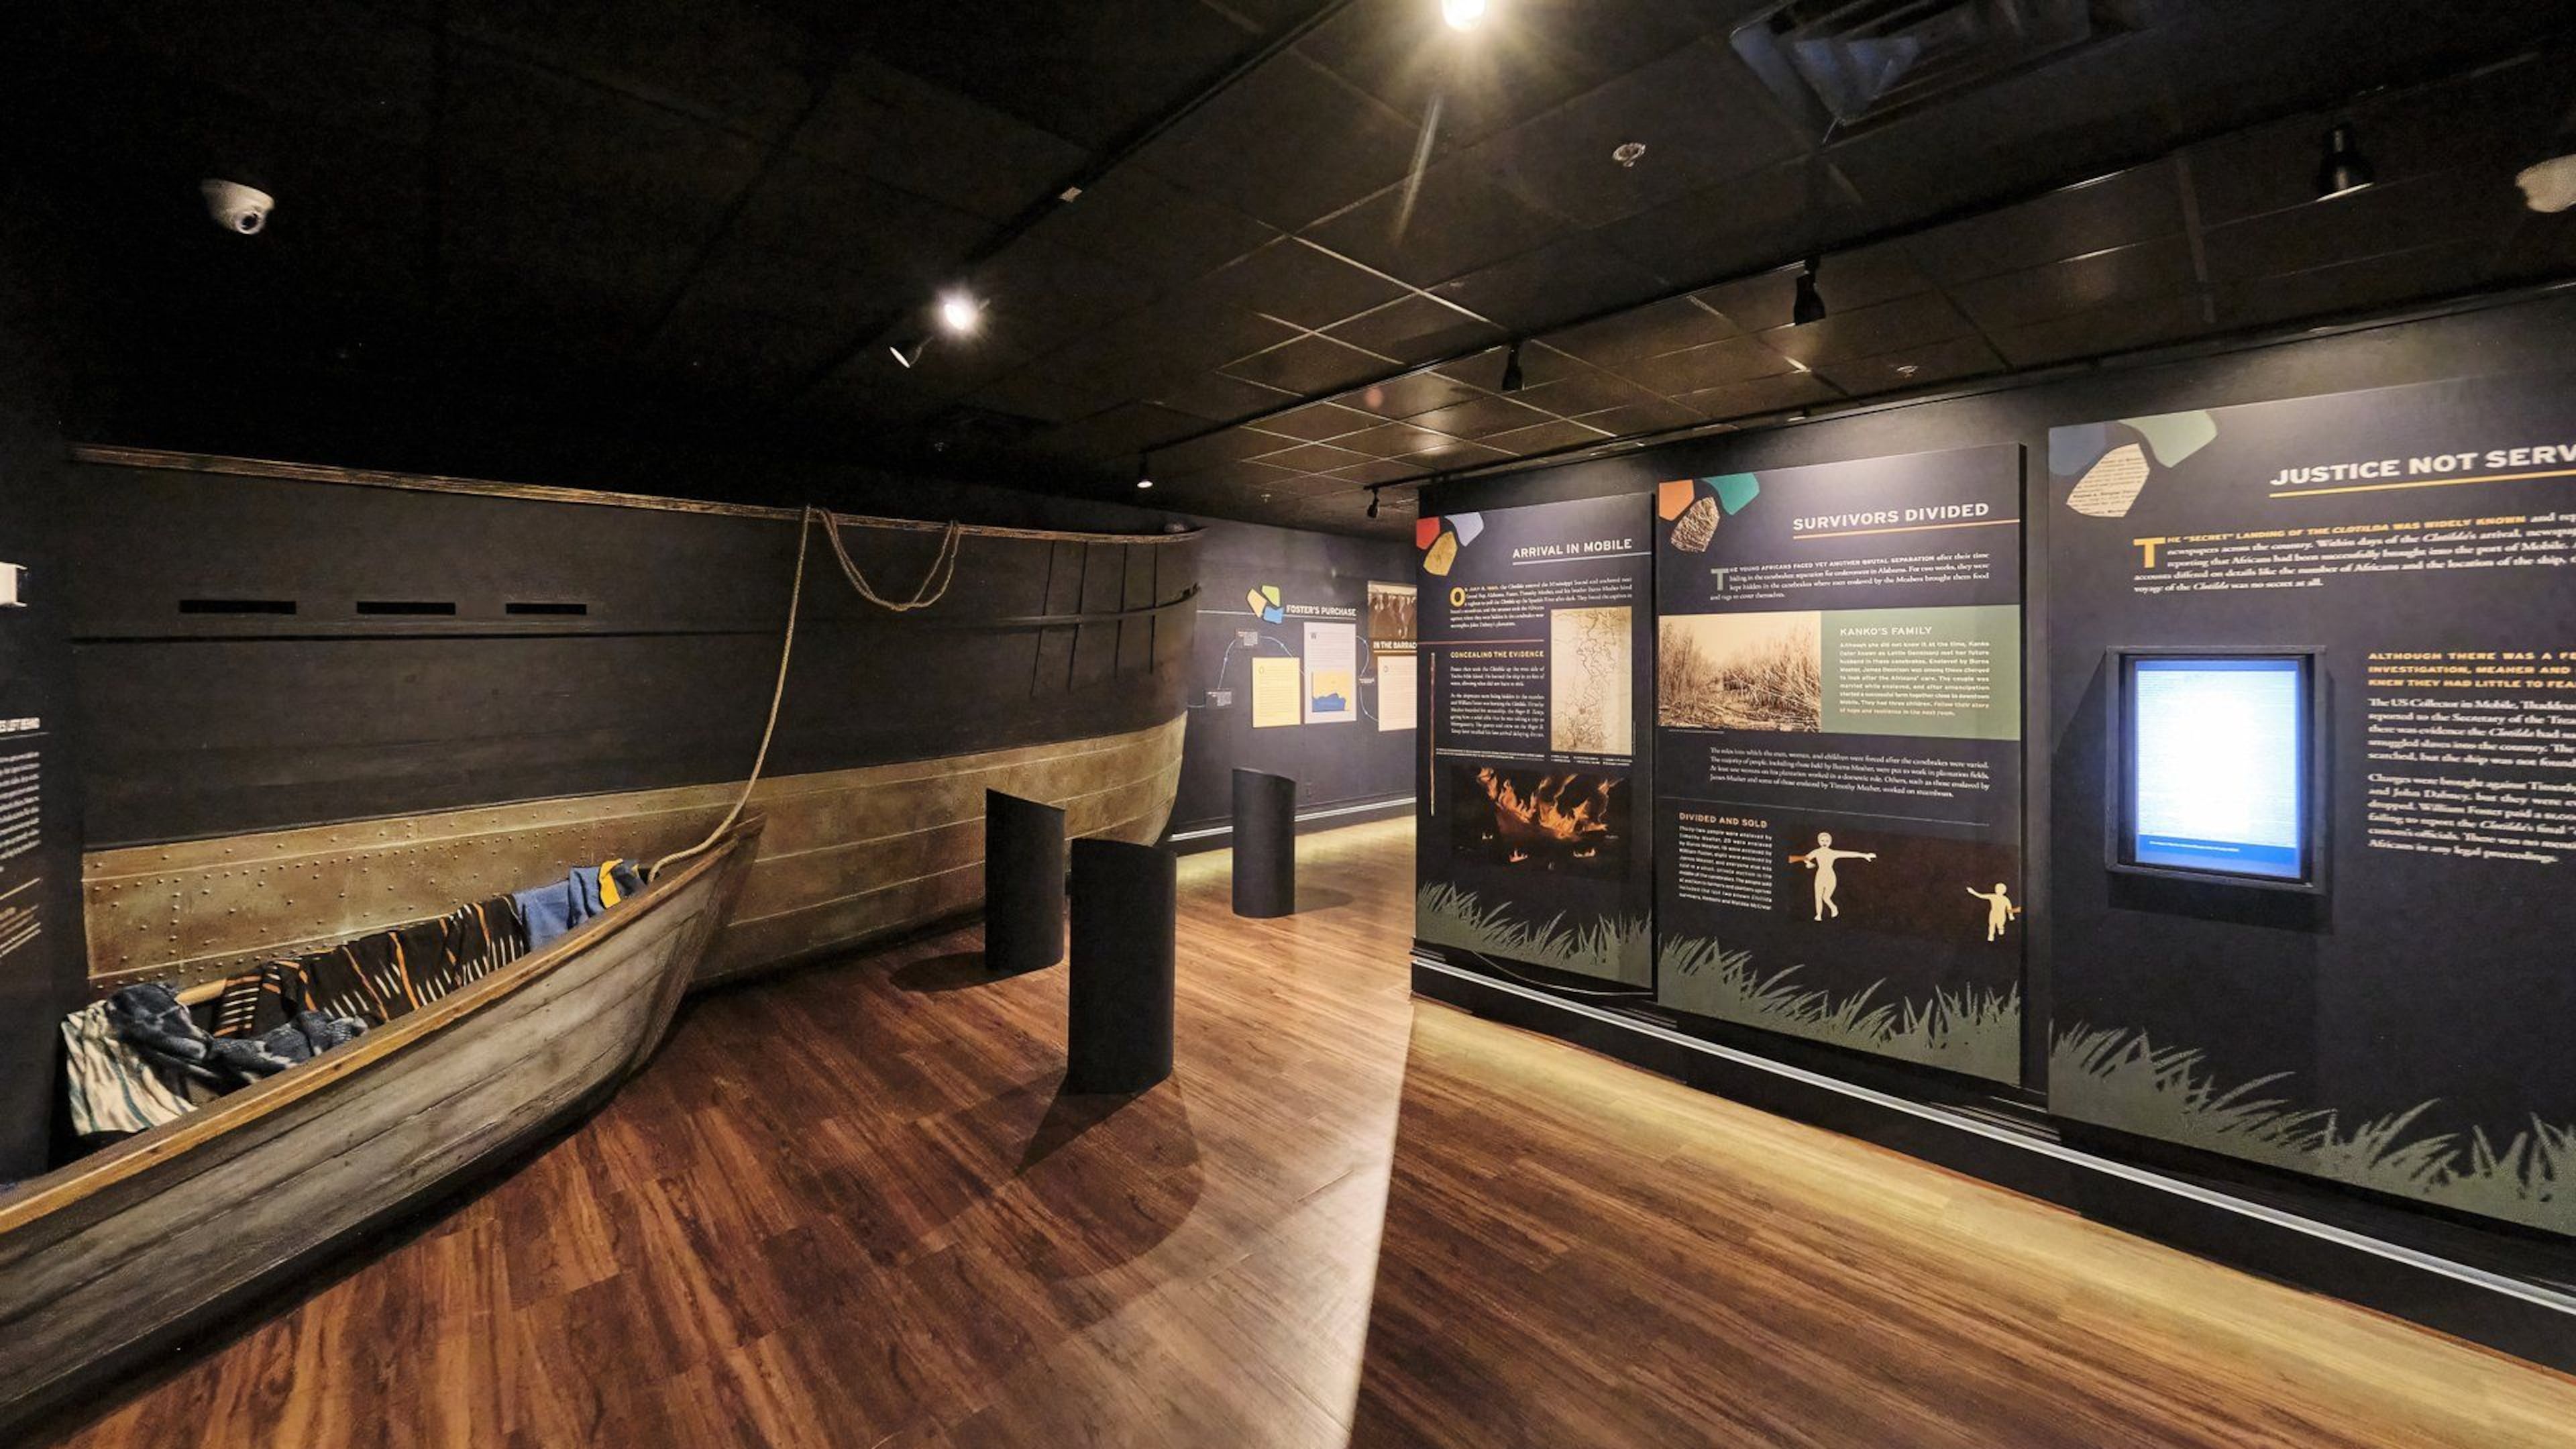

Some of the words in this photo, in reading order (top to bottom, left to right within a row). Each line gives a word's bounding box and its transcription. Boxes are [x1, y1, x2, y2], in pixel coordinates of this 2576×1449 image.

[2270, 460, 2400, 486] JUSTICE
[2409, 452, 2479, 475] NOT
[2485, 443, 2576, 468] SERV
[1793, 510, 1900, 531] SURVIVORS
[1904, 502, 1990, 522] DIVIDED
[2236, 530, 2285, 539] LANDING
[2307, 527, 2330, 535] THE
[2393, 522, 2420, 530] WAS
[2424, 519, 2472, 528] WIDELY
[2475, 516, 2526, 525] KNOWN
[2530, 512, 2556, 523] and
[1512, 543, 1564, 559] ARRIVAL
[1566, 542, 1578, 554] IN
[1583, 538, 1632, 553] MOBILE
[2252, 542, 2269, 551] the
[2357, 535, 2383, 547] days
[2384, 535, 2398, 545] of
[2400, 534, 2420, 543] the
[2210, 556, 2229, 566] that
[2231, 555, 2271, 566] Africans
[2273, 553, 2292, 563] had
[2294, 551, 2318, 561] been
[2382, 547, 2426, 559] brought
[2455, 545, 2474, 555] the
[2476, 545, 2502, 555] port
[2504, 542, 2520, 553] of
[1761, 564, 1792, 572] AFRICANS
[1829, 559, 1860, 568] ANOTHER
[1890, 555, 1935, 564] SEPARATION
[2210, 570, 2223, 578] on
[2224, 567, 2257, 578] details
[2258, 566, 2276, 576] like
[2278, 566, 2296, 576] the
[2340, 562, 2354, 573] of
[2401, 559, 2424, 570] and
[2426, 559, 2445, 569] the
[2447, 557, 2494, 568] location
[2496, 555, 2512, 566] of
[2513, 555, 2534, 566] the
[2165, 582, 2176, 592] of
[2177, 581, 2191, 592] the
[2231, 581, 2249, 590] was
[2251, 580, 2265, 588] no
[2295, 579, 2306, 588] at
[1286, 604, 1320, 615] FOSTER'S
[1321, 606, 1356, 616] PURCHASE
[1839, 627, 1888, 636] KANKO'S
[1891, 626, 1933, 635] FAMILY
[1450, 651, 1493, 659] CONCEALING
[1494, 651, 1508, 659] THE
[1509, 650, 1545, 658] EVIDENCE
[2368, 651, 2443, 660] ALTHOUGH
[2447, 651, 2497, 660] THERE
[2502, 651, 2535, 660] WAS
[2540, 652, 2553, 660] A
[2539, 666, 2571, 675] AND
[2406, 679, 2441, 688] THEY
[2443, 680, 2472, 688] HAD
[2475, 680, 2522, 688] LITTLE
[2526, 680, 2544, 688] TO
[2368, 698, 2389, 707] The
[2460, 700, 2473, 709] in
[2416, 713, 2430, 722] to
[2431, 712, 2451, 722] the
[2508, 714, 2524, 724] of
[2524, 714, 2545, 724] the
[2467, 727, 2487, 737] the
[2536, 729, 2560, 739] had
[2478, 741, 2498, 751] the
[2441, 753, 2462, 763] the
[2368, 787, 2390, 796] and
[2500, 794, 2529, 805] they
[1678, 812, 1717, 824] DIVIDED
[1719, 816, 1739, 826] AND
[1741, 818, 1768, 829] SOLD
[2457, 818, 2477, 828] the
